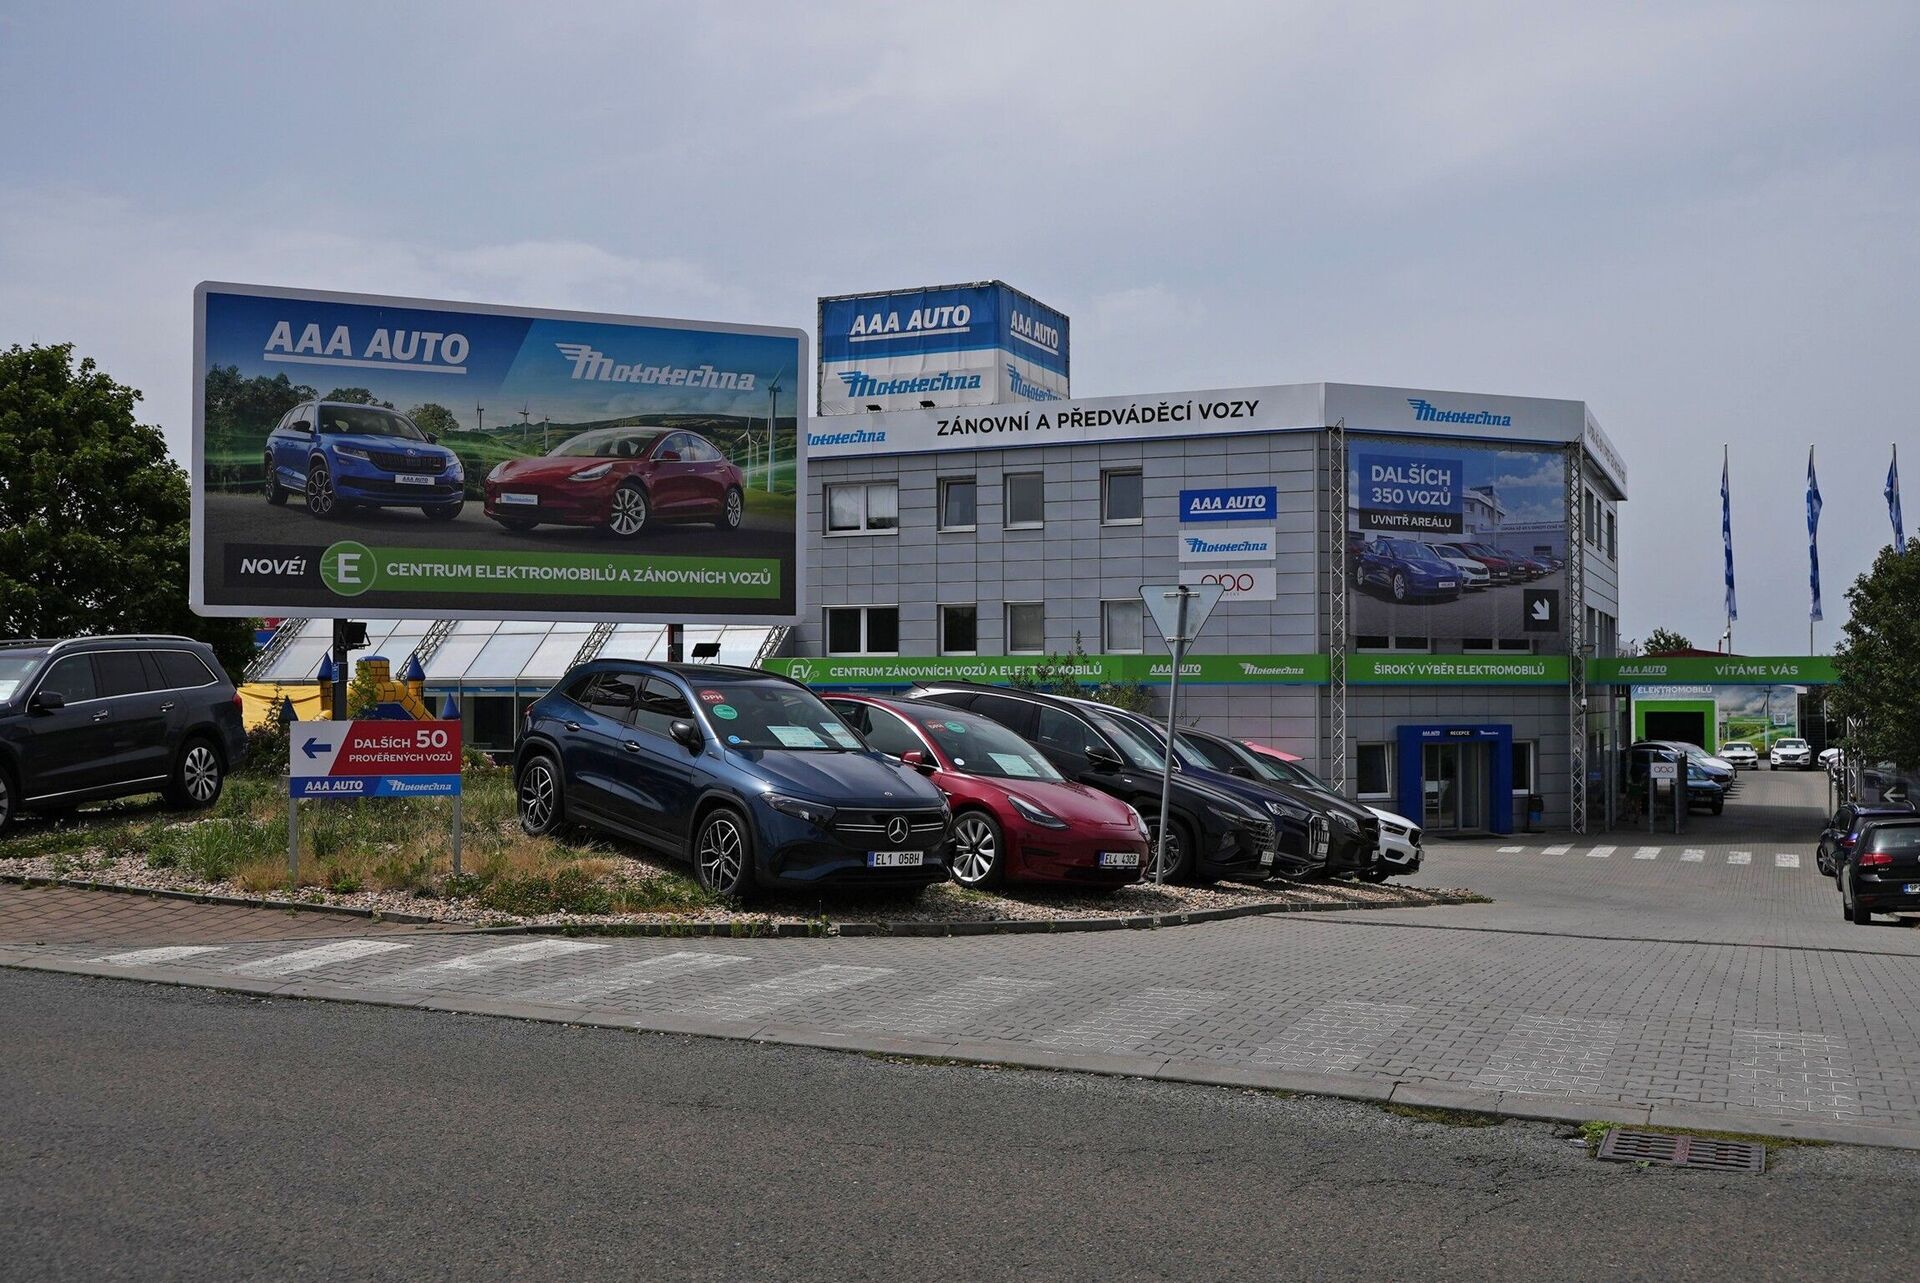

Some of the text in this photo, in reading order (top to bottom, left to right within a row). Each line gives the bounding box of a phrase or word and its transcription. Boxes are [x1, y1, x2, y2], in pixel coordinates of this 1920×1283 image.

[850, 305, 970, 335] AAA AUTO
[1011, 311, 1058, 349] AAA AUTO
[264, 321, 470, 364] AAA AUTO
[555, 342, 755, 391] Mototechna
[837, 370, 981, 398] Mototechna
[937, 400, 1260, 436] ZÁNOVNÍ A PŘEDVÁDĚCÍ VOZY
[1407, 398, 1511, 426] Mototechna
[808, 429, 886, 446] ototechna
[1371, 463, 1451, 486] DALŠÍCH
[1190, 495, 1266, 510] AAA AUTO
[1371, 487, 1451, 506] 350 VOZŮ
[1371, 514, 1452, 528] UVNITŘ AREÁLU
[1184, 538, 1268, 553] Mototechna
[240, 556, 307, 576] NOVÉ!
[337, 553, 362, 584] E
[386, 562, 771, 585] CENTRUM ELEKTROMOBILŮ A ZÁNOVNÍCH VOZŮ
[791, 665, 812, 679] EV
[830, 667, 883, 677] CENTRUM
[886, 664, 952, 677] ZÁNOVNÍCH
[955, 662, 986, 676] VOZŮ
[989, 666, 998, 676] A
[1150, 664, 1201, 673] AAA UTO
[1239, 663, 1304, 675] Mototechna
[1374, 662, 1545, 675] ŠIROKÝ VÝBĚR ELEKTROMOBILŮ
[1619, 665, 1667, 674] AAA AUTO
[1714, 664, 1799, 675] VÍTÁME VÁS
[1638, 685, 1712, 694] ELEKTROMOBILŮ
[354, 729, 448, 749] DALŠÍCH 50
[349, 751, 453, 763] PROVĚŘENÝCH VOZŮ
[305, 780, 363, 791] AAA AUTO
[387, 779, 452, 792] Mototechna
[876, 853, 892, 865] EL1
